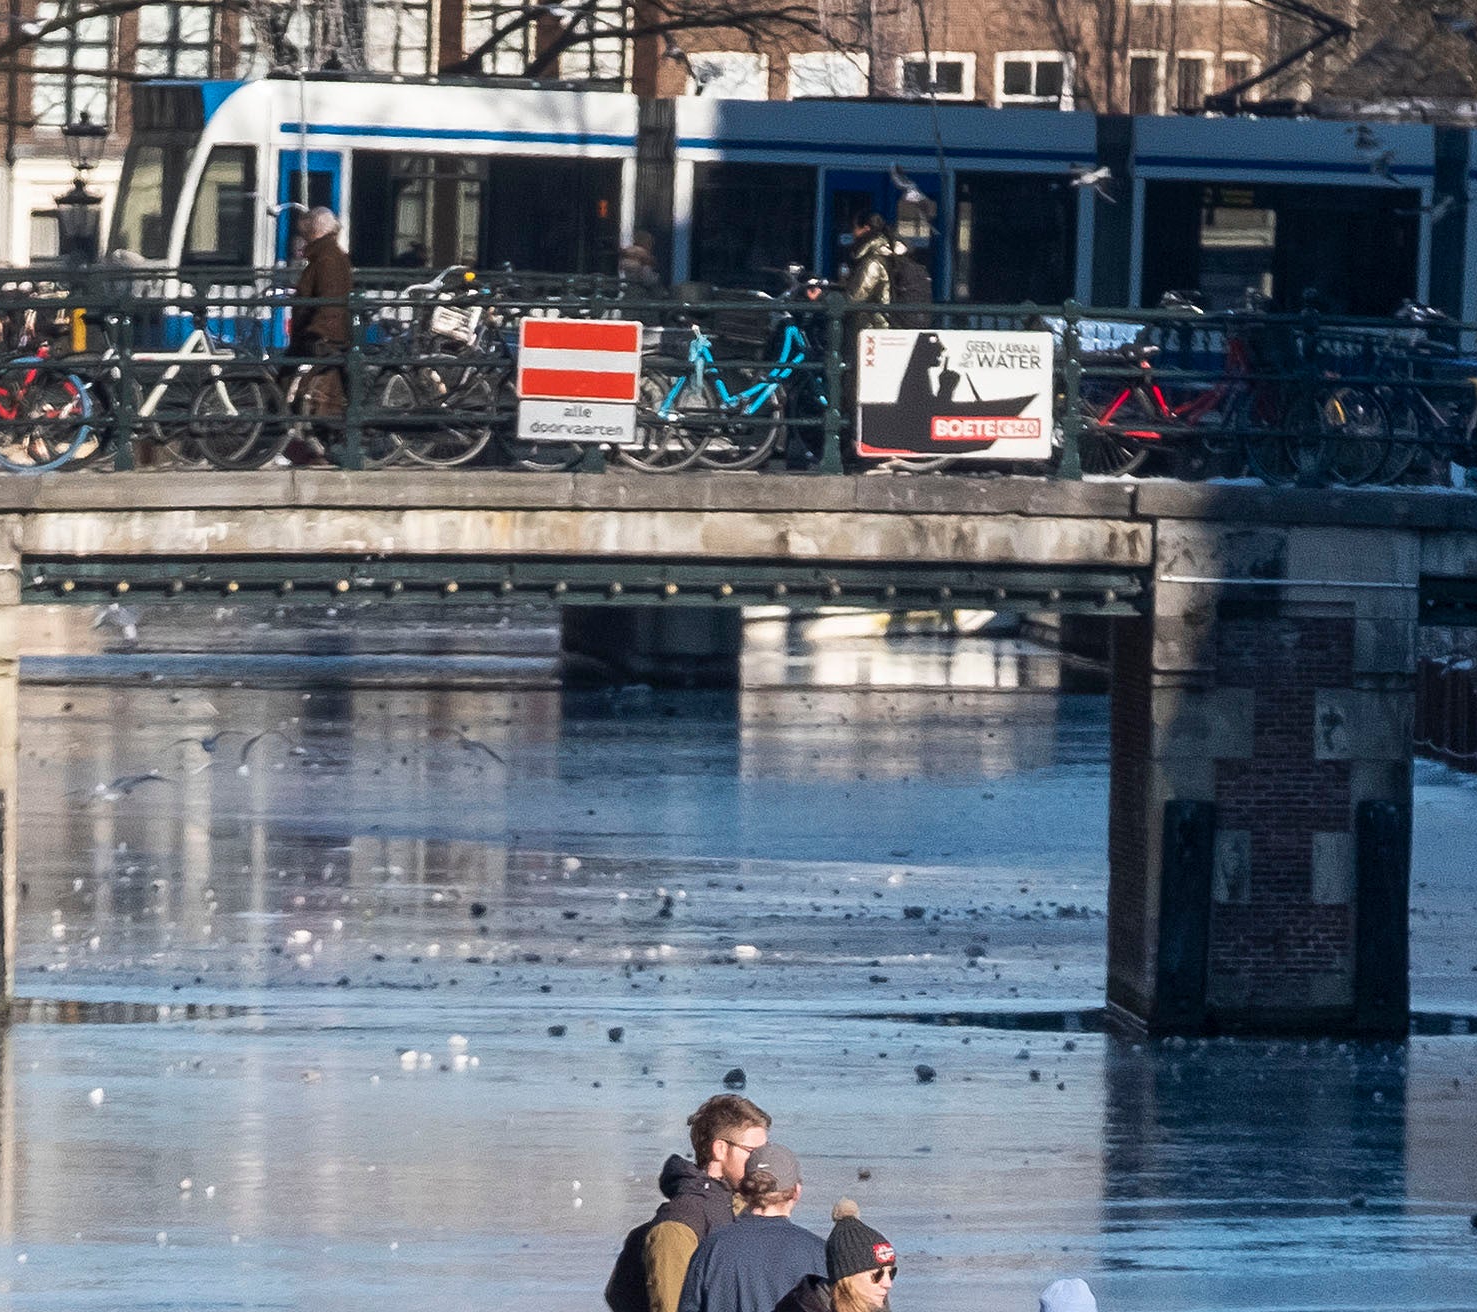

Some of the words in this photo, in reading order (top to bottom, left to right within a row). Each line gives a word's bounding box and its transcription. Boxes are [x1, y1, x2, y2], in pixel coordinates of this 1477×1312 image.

[966, 340, 996, 354] GEEN
[999, 343, 1040, 355] LAWAAI
[976, 352, 1042, 370] WATER
[563, 405, 593, 418] alle
[529, 420, 624, 436] doorvaarten
[934, 417, 997, 438] BOETE
